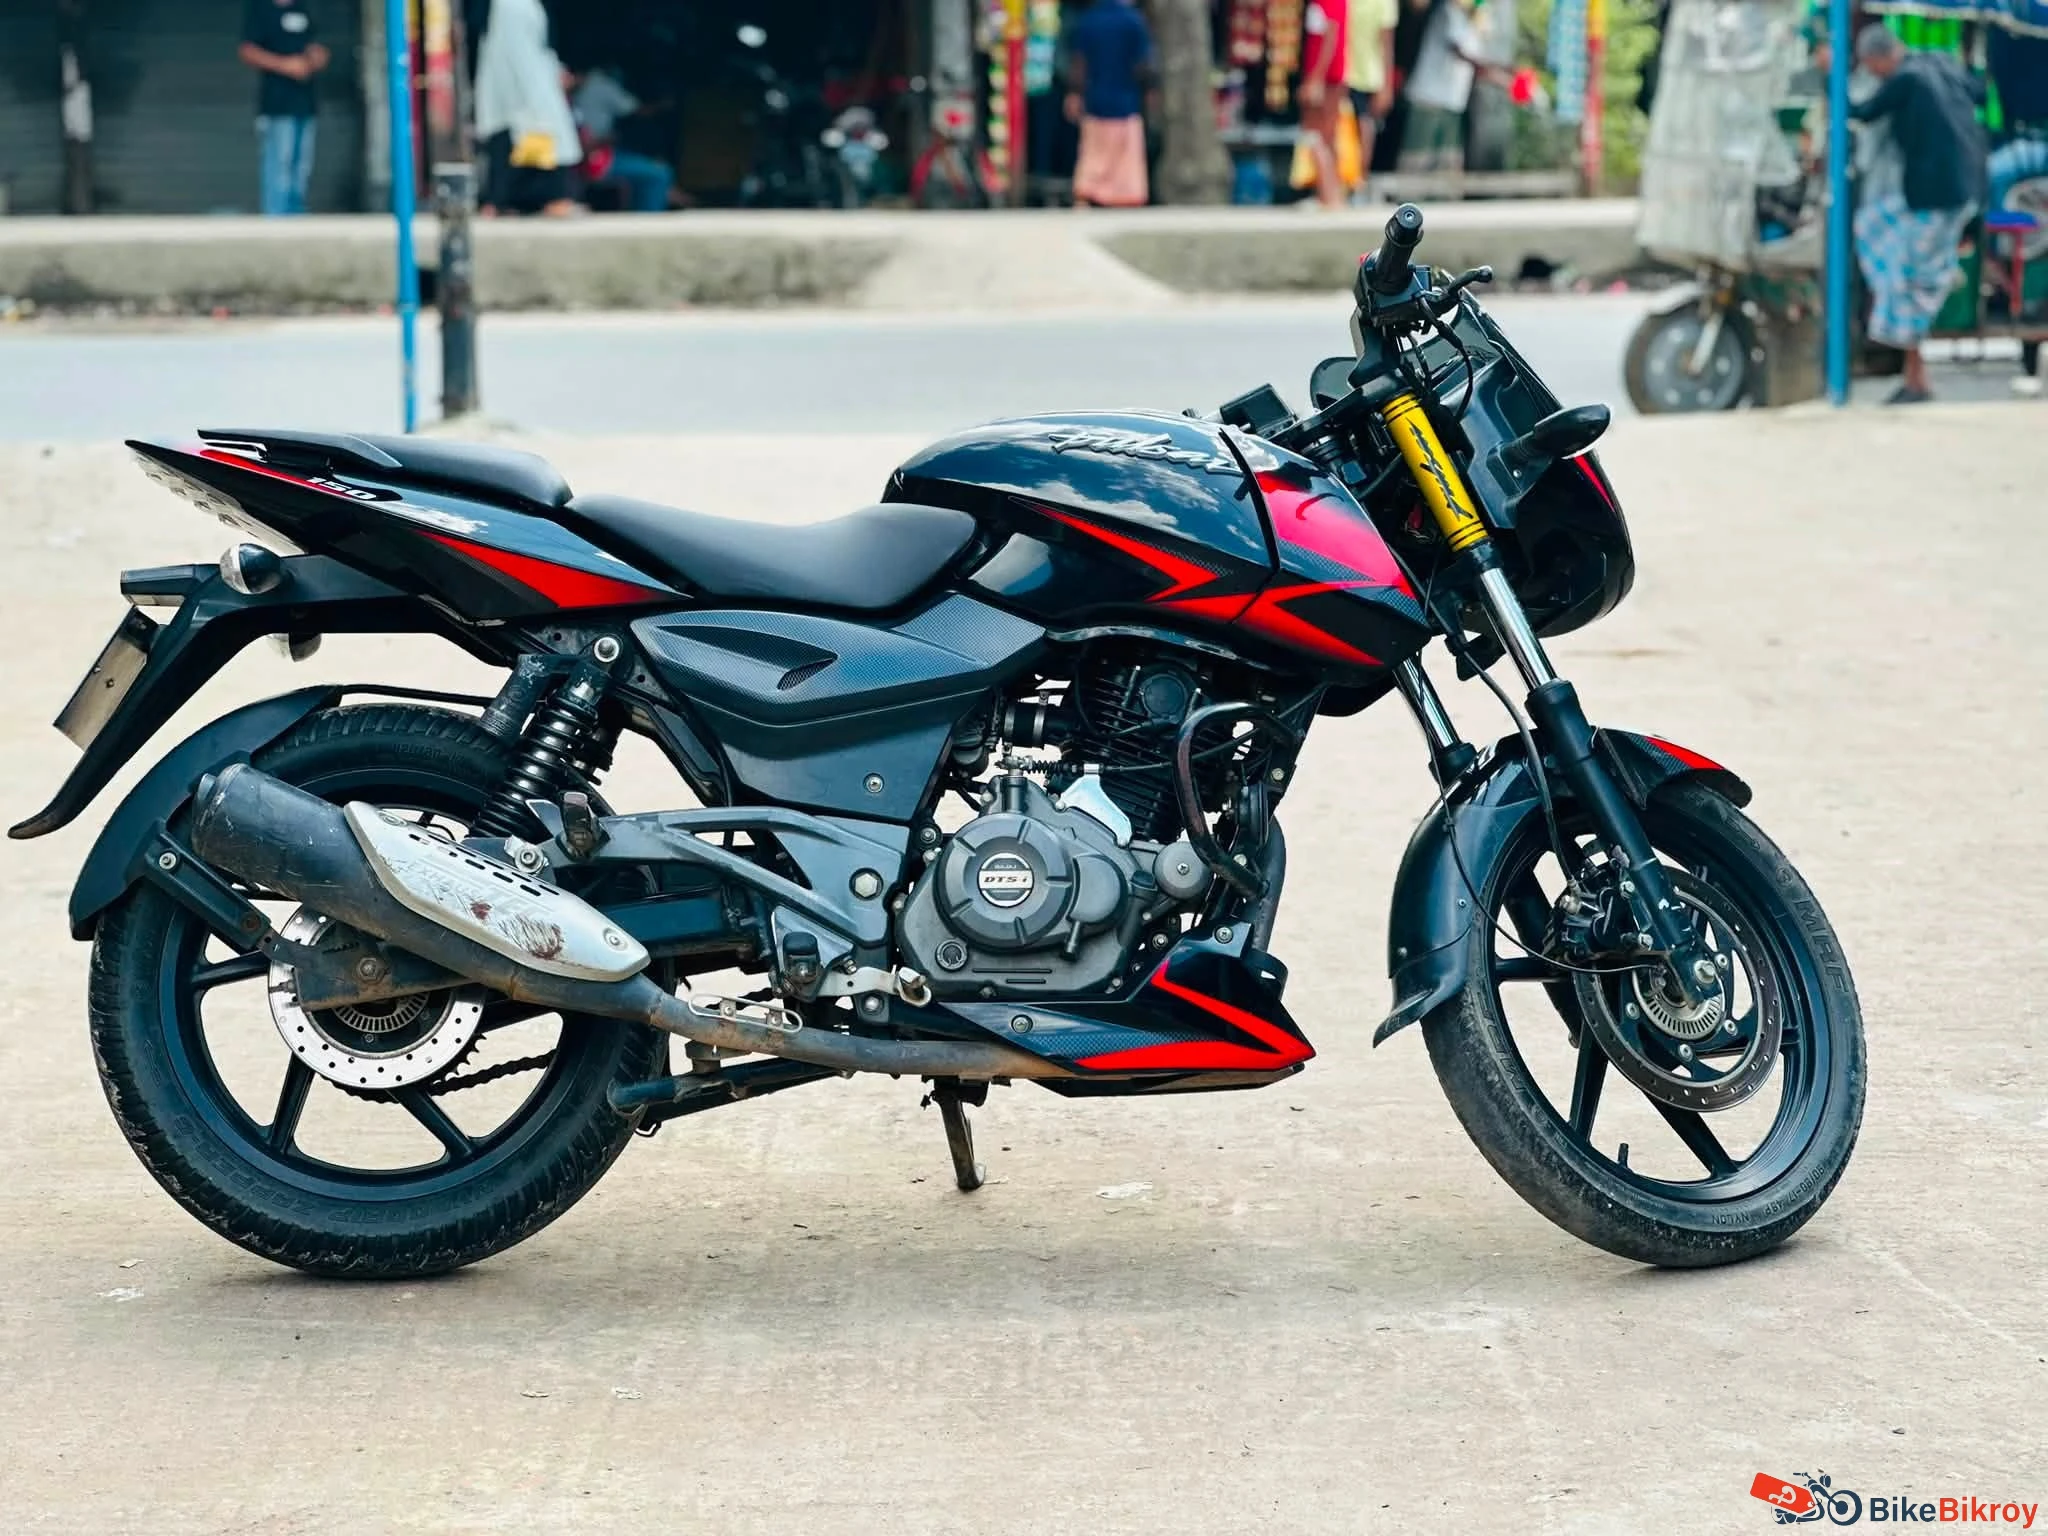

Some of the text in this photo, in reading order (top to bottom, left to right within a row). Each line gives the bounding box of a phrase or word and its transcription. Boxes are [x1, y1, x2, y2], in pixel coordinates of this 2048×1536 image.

[306, 476, 377, 501] 150
[1791, 897, 1850, 994] MRF
[1711, 1210, 1751, 1227] NYLON
